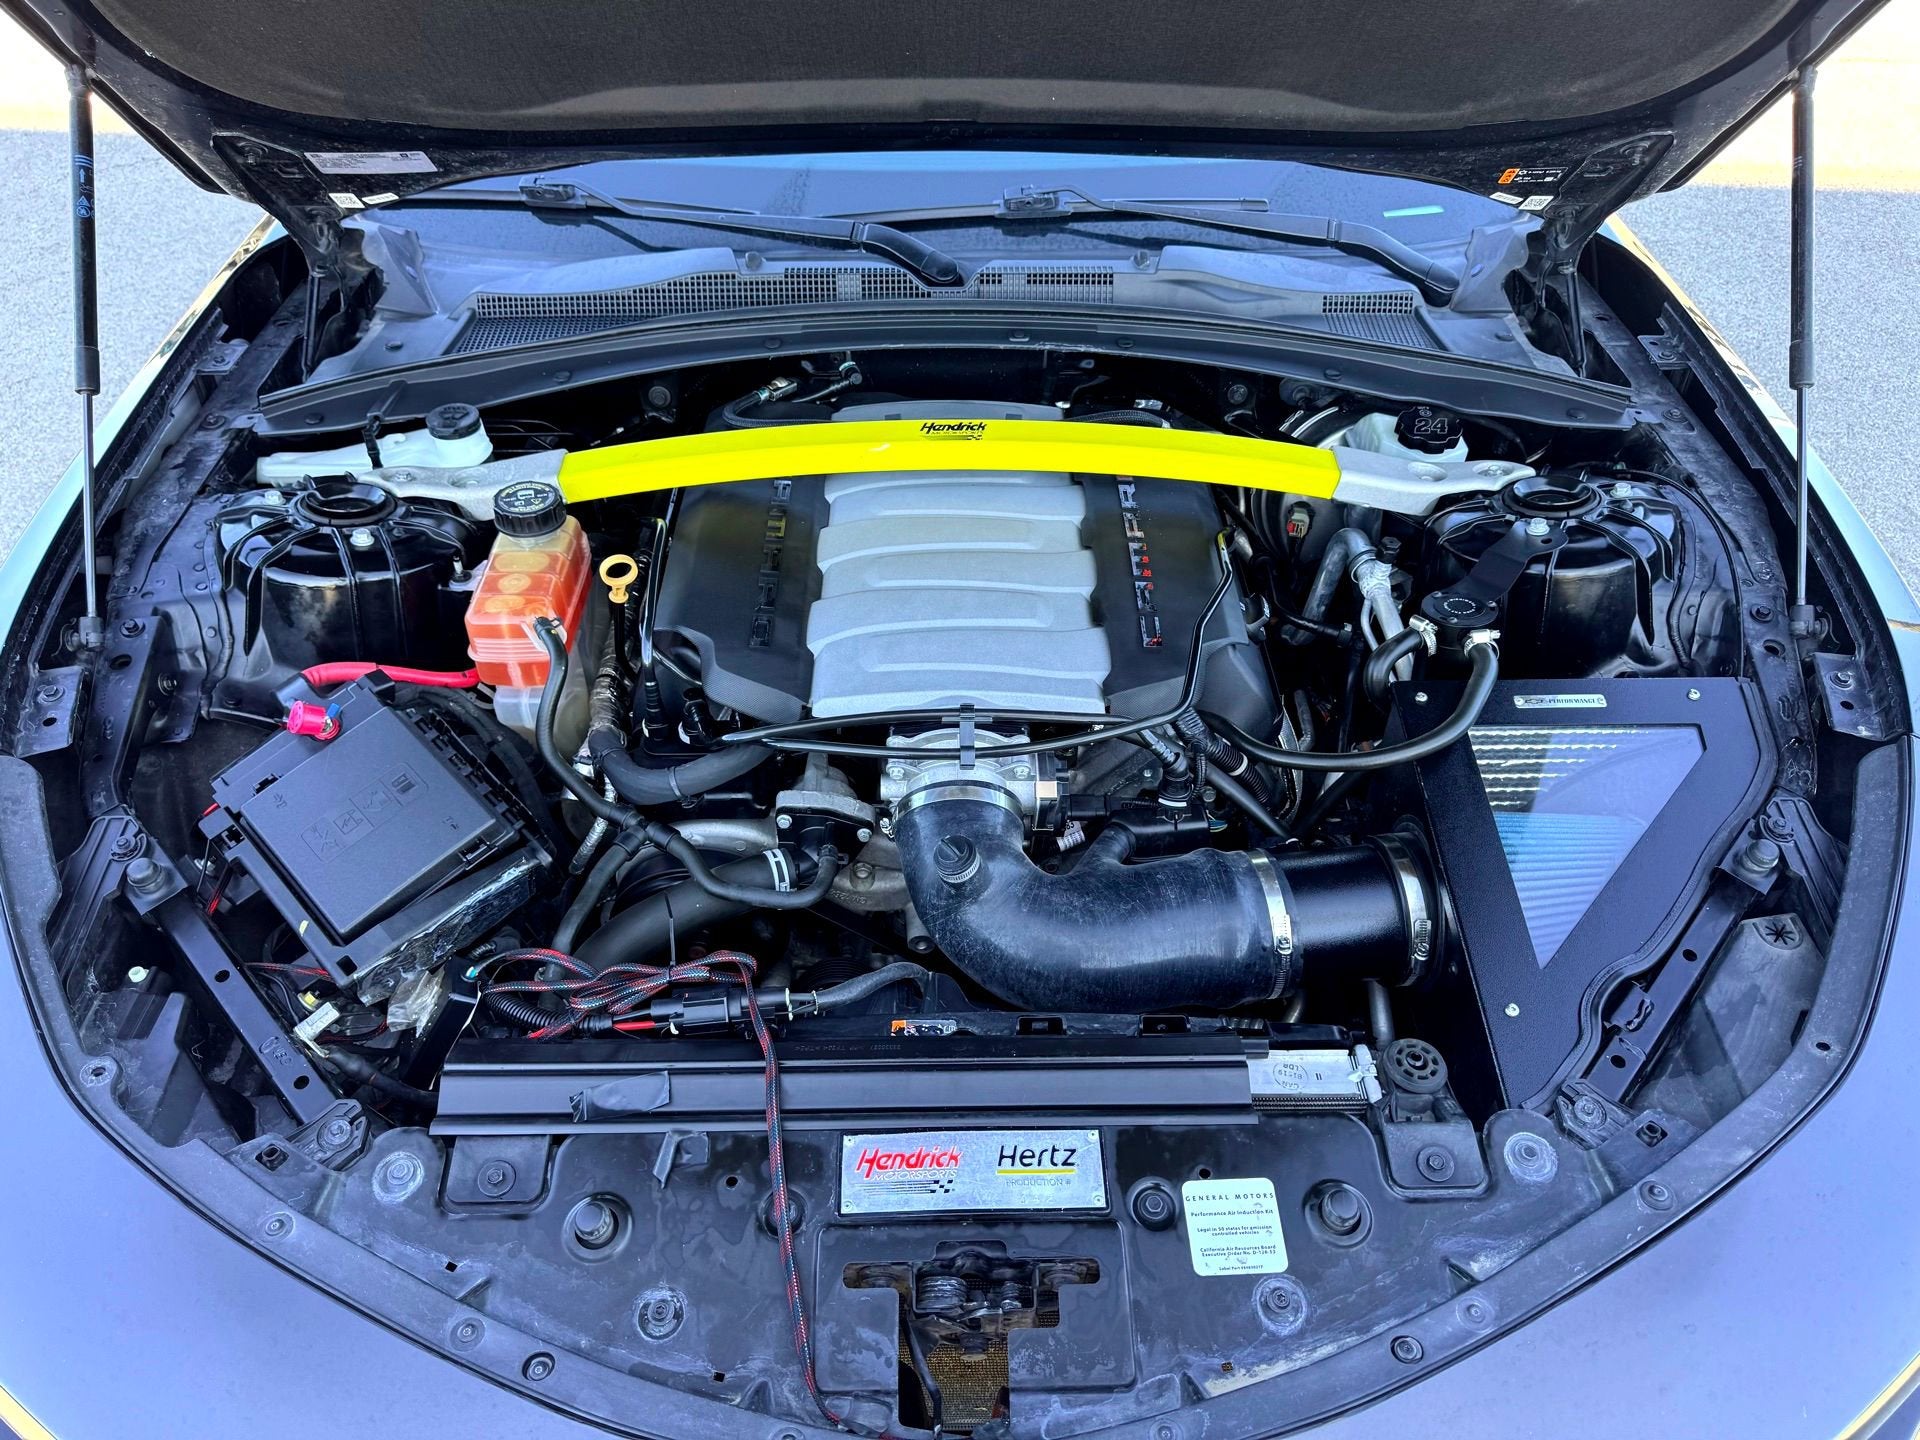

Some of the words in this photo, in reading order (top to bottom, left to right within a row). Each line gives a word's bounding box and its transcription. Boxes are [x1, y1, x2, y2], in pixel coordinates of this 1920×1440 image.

[919, 422, 987, 434] Hendrick
[1413, 417, 1448, 434] 24
[1116, 476, 1163, 647] CAMAR
[855, 1145, 963, 1180] Hendrick
[997, 1145, 1076, 1167] Hertz
[873, 1169, 957, 1180] MOTORSPORTS
[1006, 1178, 1063, 1186] PRODUCTION
[1185, 1194, 1229, 1202] GENERAL
